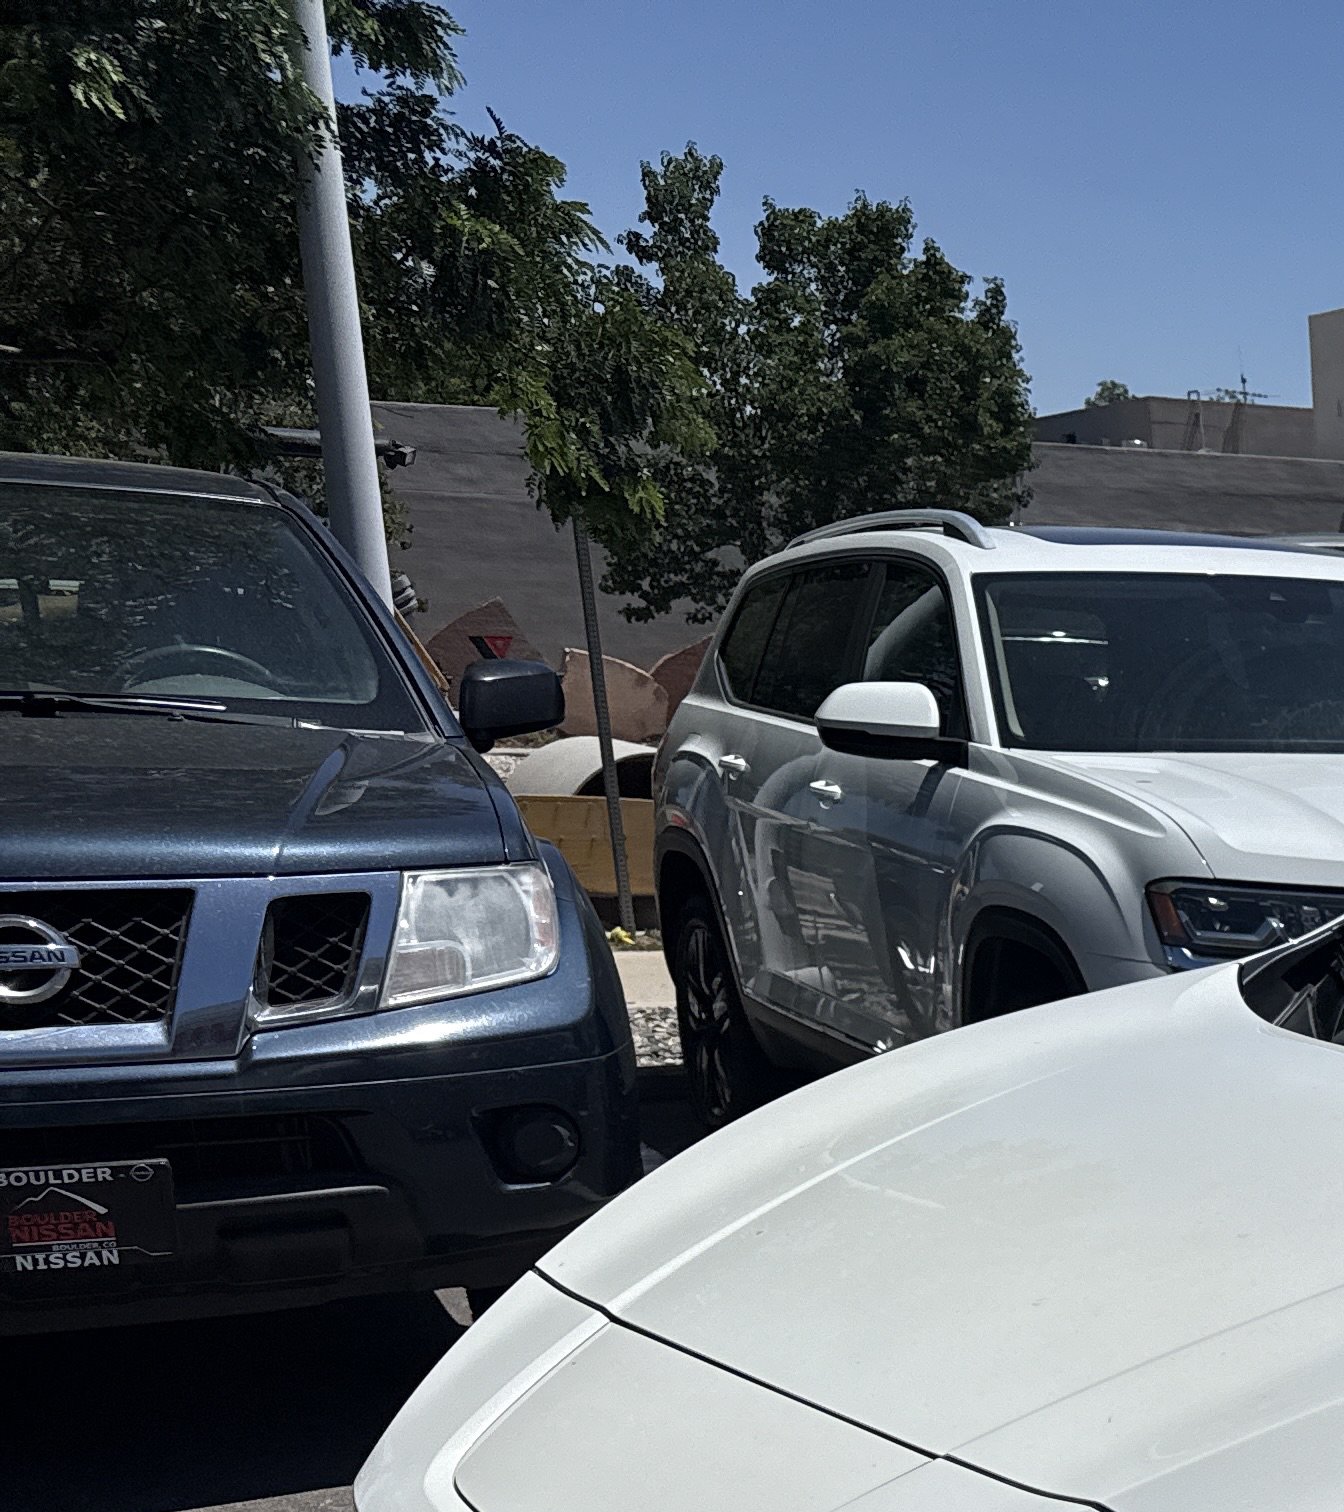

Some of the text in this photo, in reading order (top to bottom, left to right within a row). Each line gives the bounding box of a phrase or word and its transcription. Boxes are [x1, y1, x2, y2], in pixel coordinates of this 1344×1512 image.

[8, 1210, 98, 1226] BOULDER
[9, 1221, 116, 1242] NISSAN
[15, 1249, 120, 1272] NISSAN
